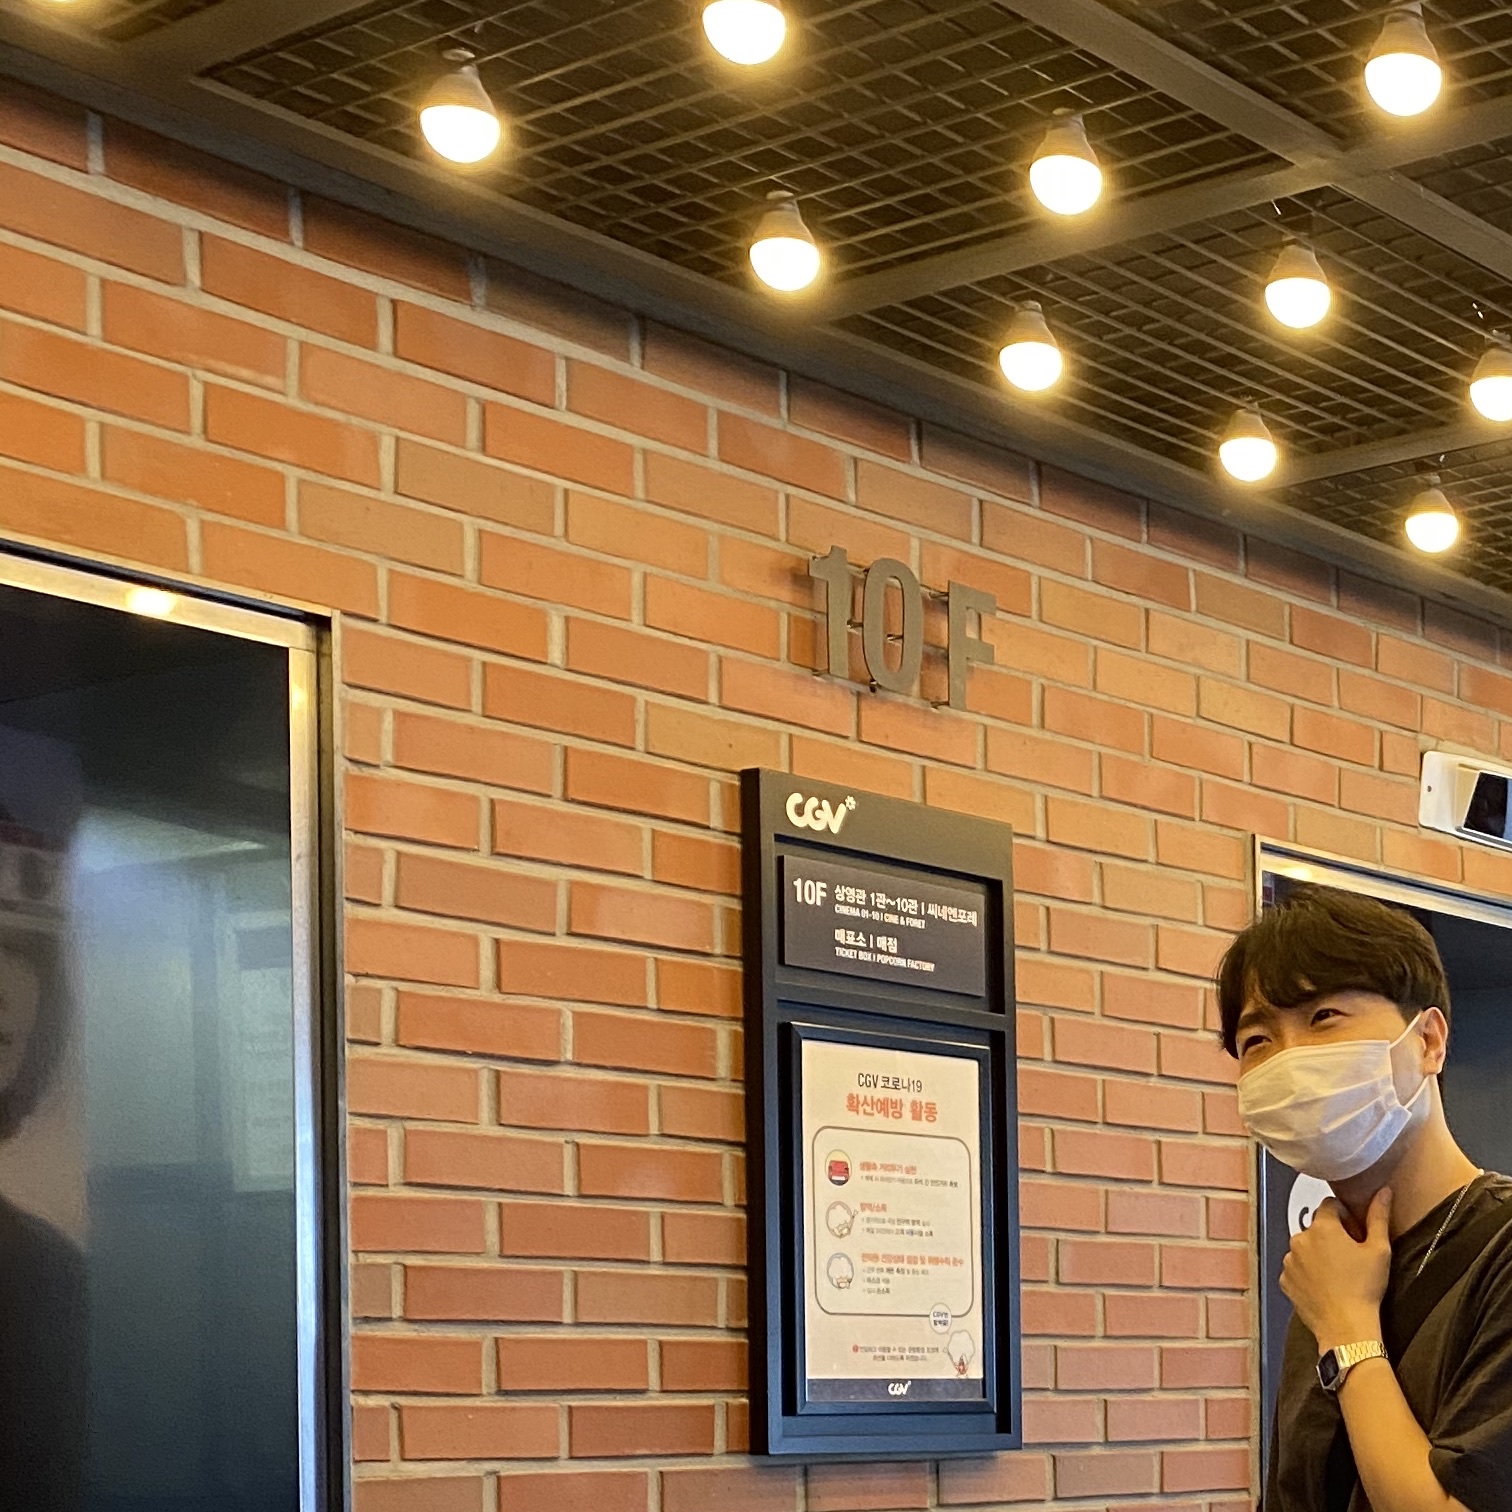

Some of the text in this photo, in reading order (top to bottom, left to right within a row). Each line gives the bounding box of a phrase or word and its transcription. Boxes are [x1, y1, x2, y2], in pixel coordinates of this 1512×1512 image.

[786, 792, 847, 834] CGV
[793, 878, 827, 906] 10F
[835, 885, 866, 905] 상영관
[858, 1073, 922, 1092] CGV 코로나19
[846, 1093, 938, 1122] 확산예방 활동
[888, 1382, 909, 1395] CGV
